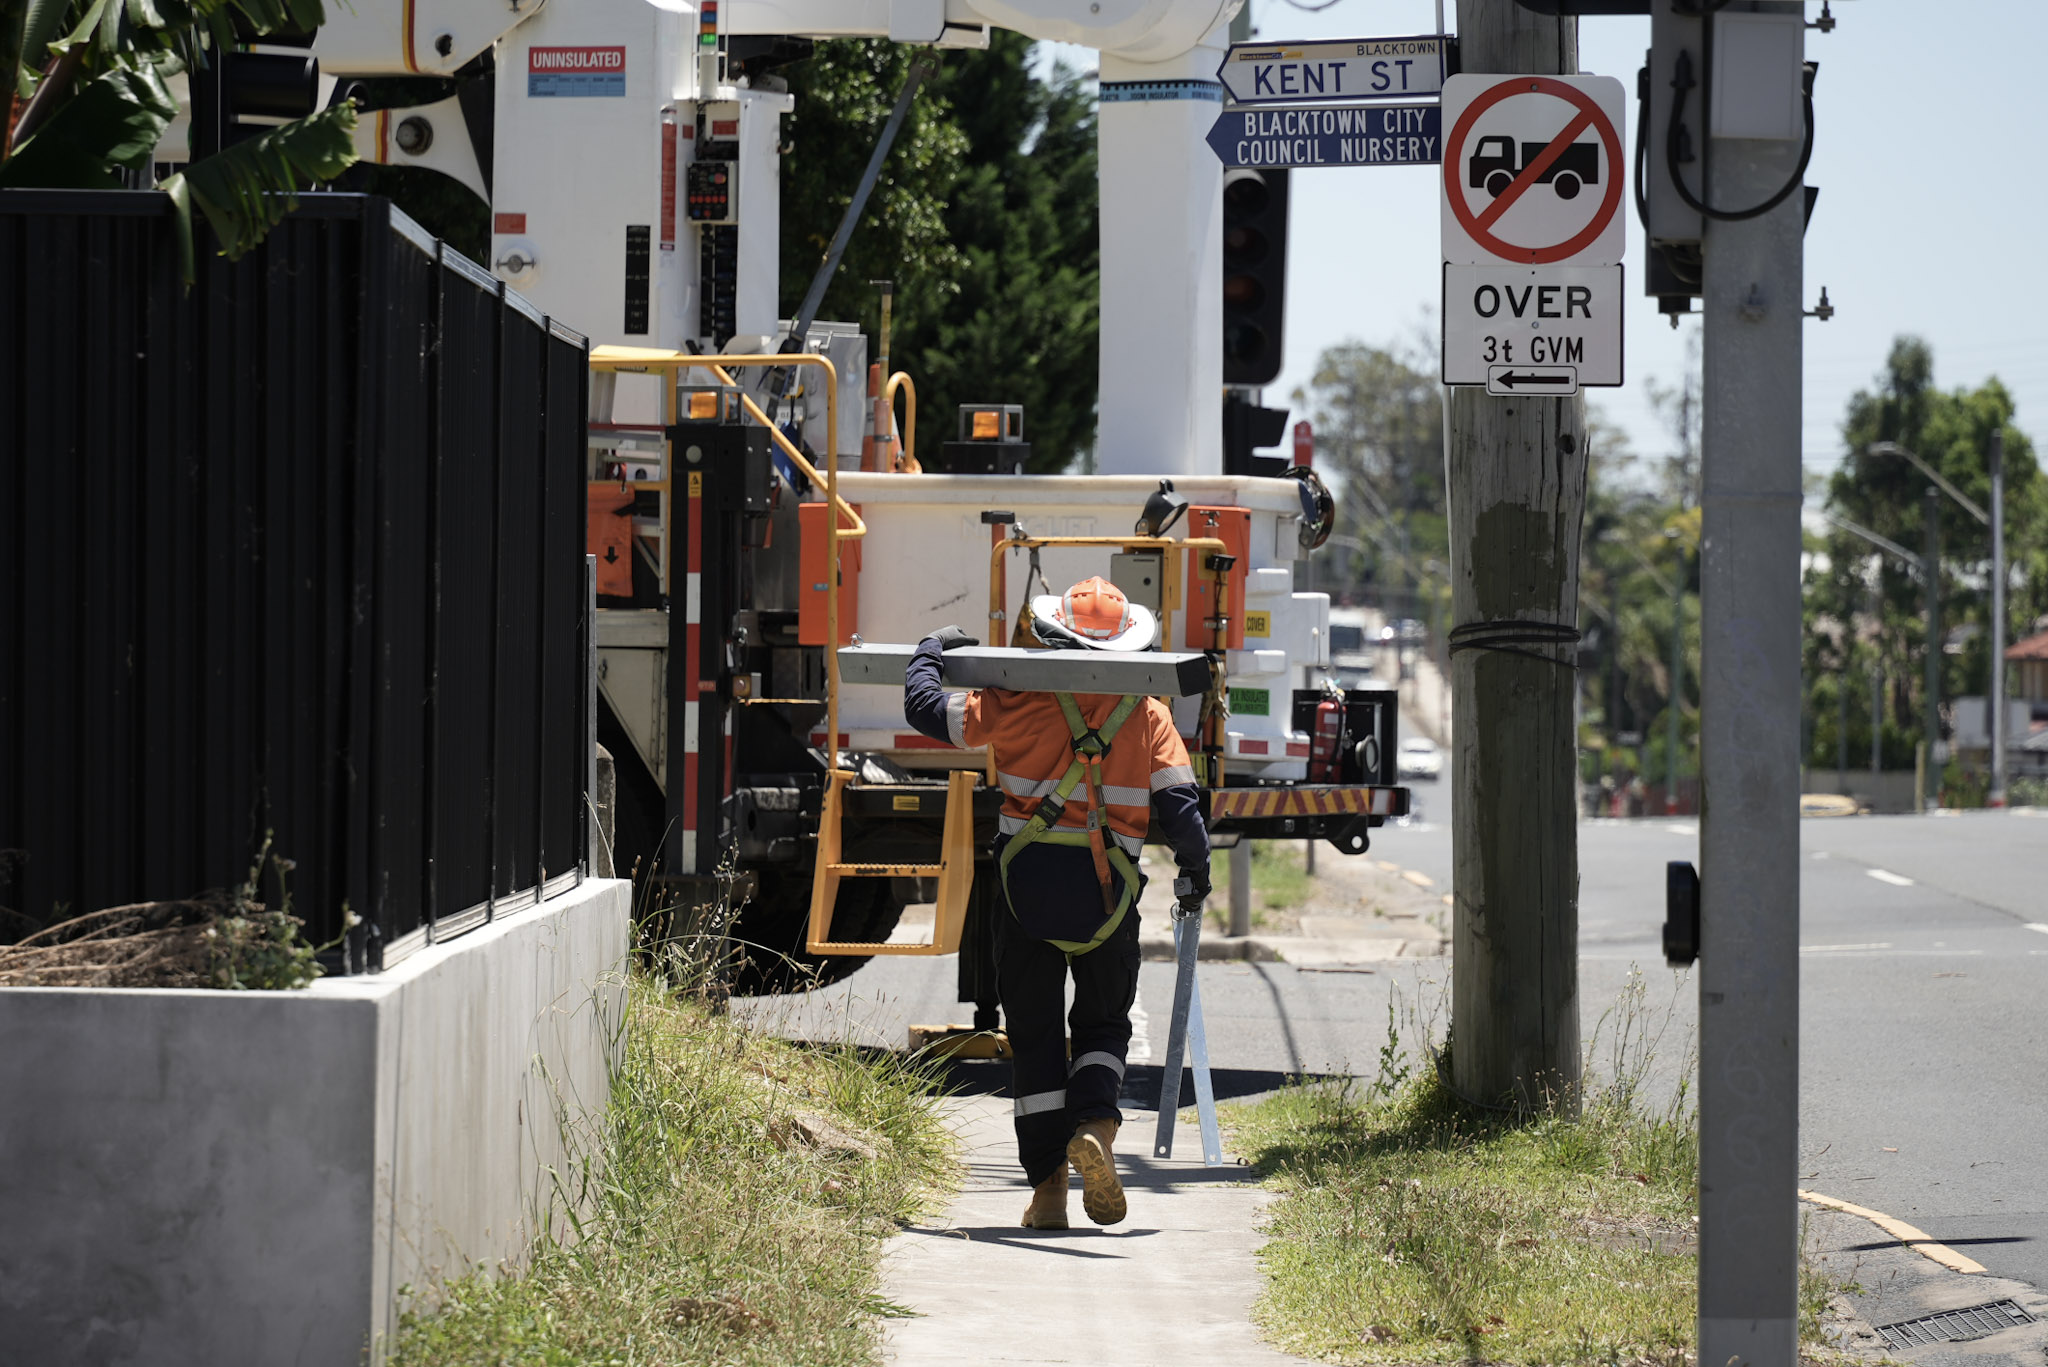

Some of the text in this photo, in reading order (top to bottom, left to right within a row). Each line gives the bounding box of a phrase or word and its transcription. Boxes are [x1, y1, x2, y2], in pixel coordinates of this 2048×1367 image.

[532, 51, 621, 69] UNINSULATED
[1356, 42, 1436, 56] BLACKTOWN
[1254, 60, 1414, 96] KENT ST
[1244, 108, 1427, 137] BLACKTOWN CITY
[1236, 136, 1436, 165] COUNCIL NURSERY
[1473, 284, 1593, 319] OVER
[1482, 335, 1584, 363] 3t GVM
[1247, 617, 1265, 632] COVER
